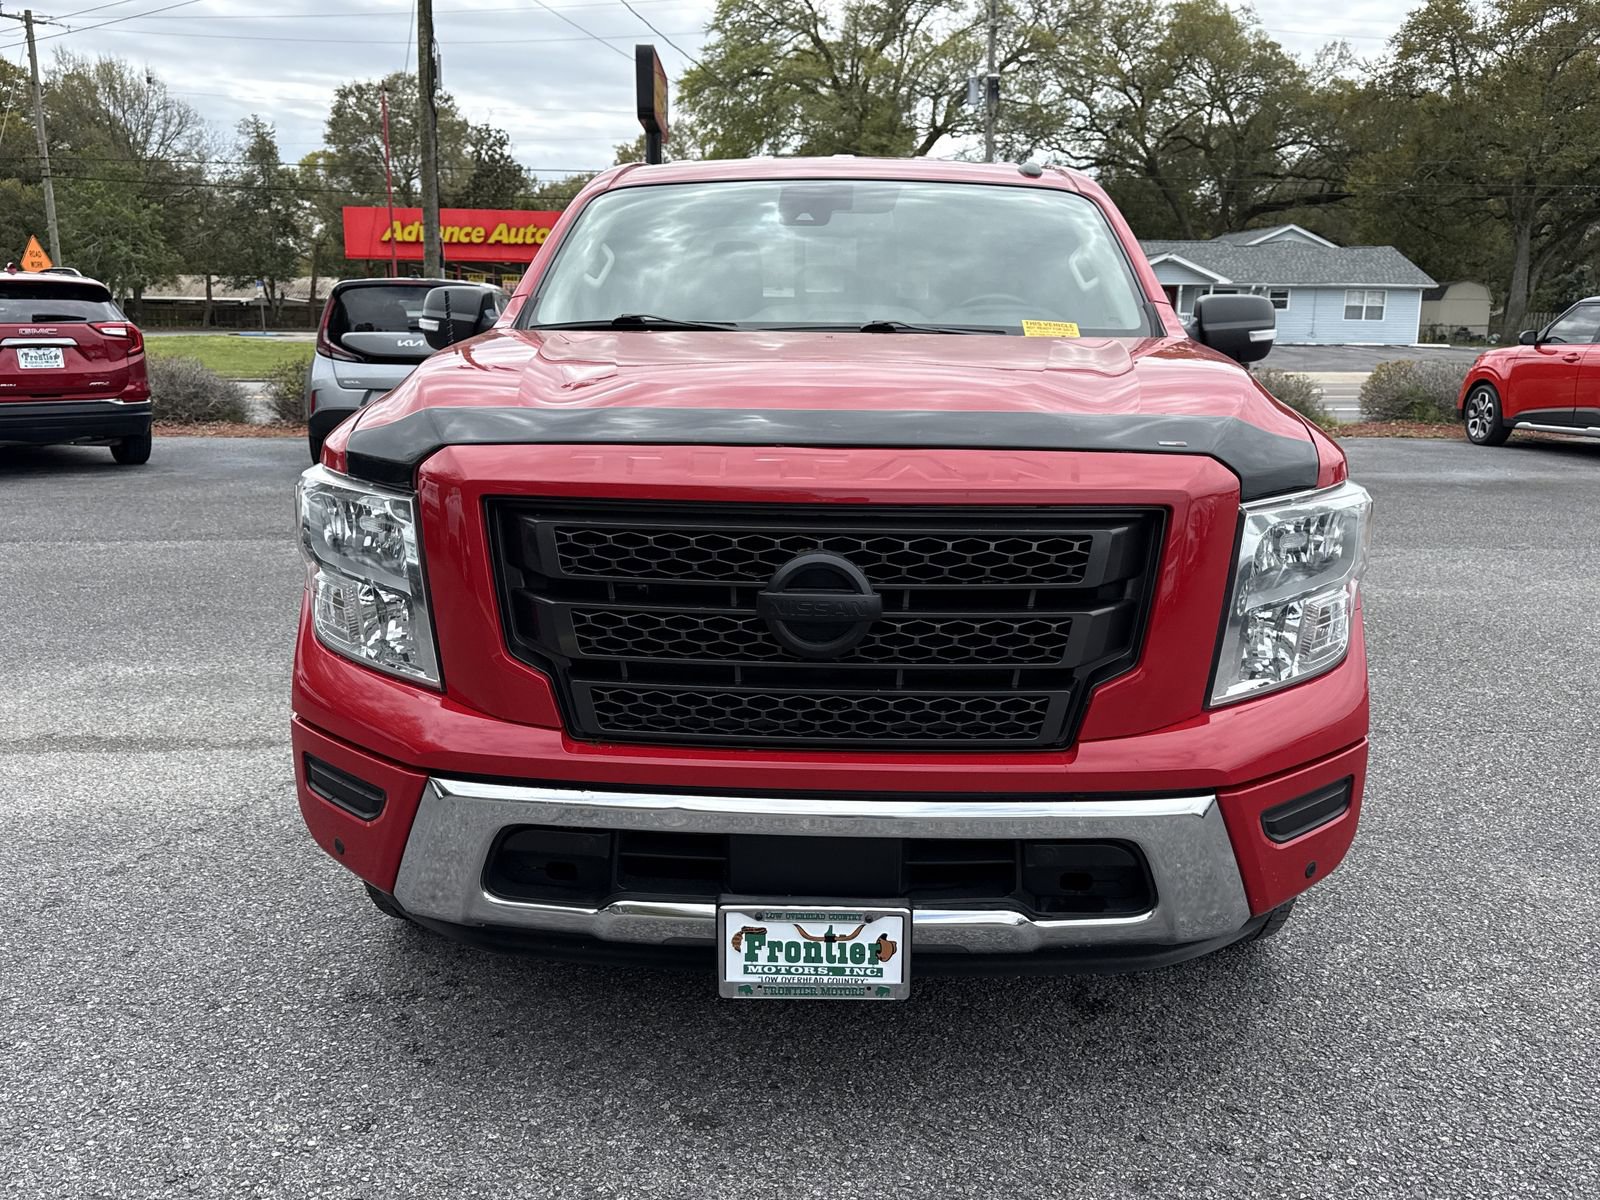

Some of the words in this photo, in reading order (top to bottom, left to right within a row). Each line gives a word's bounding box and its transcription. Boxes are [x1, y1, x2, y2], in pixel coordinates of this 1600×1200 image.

[381, 221, 485, 243] Adnce
[397, 339, 424, 347] KIA
[769, 600, 868, 617] NISSAN
[785, 912, 826, 920] OVERHEAD
[829, 913, 864, 921] COUNTRY
[744, 925, 881, 965] Frontier
[844, 967, 881, 976] INC.
[763, 985, 818, 996] FRONTIER
[820, 986, 865, 997] MOTORS
